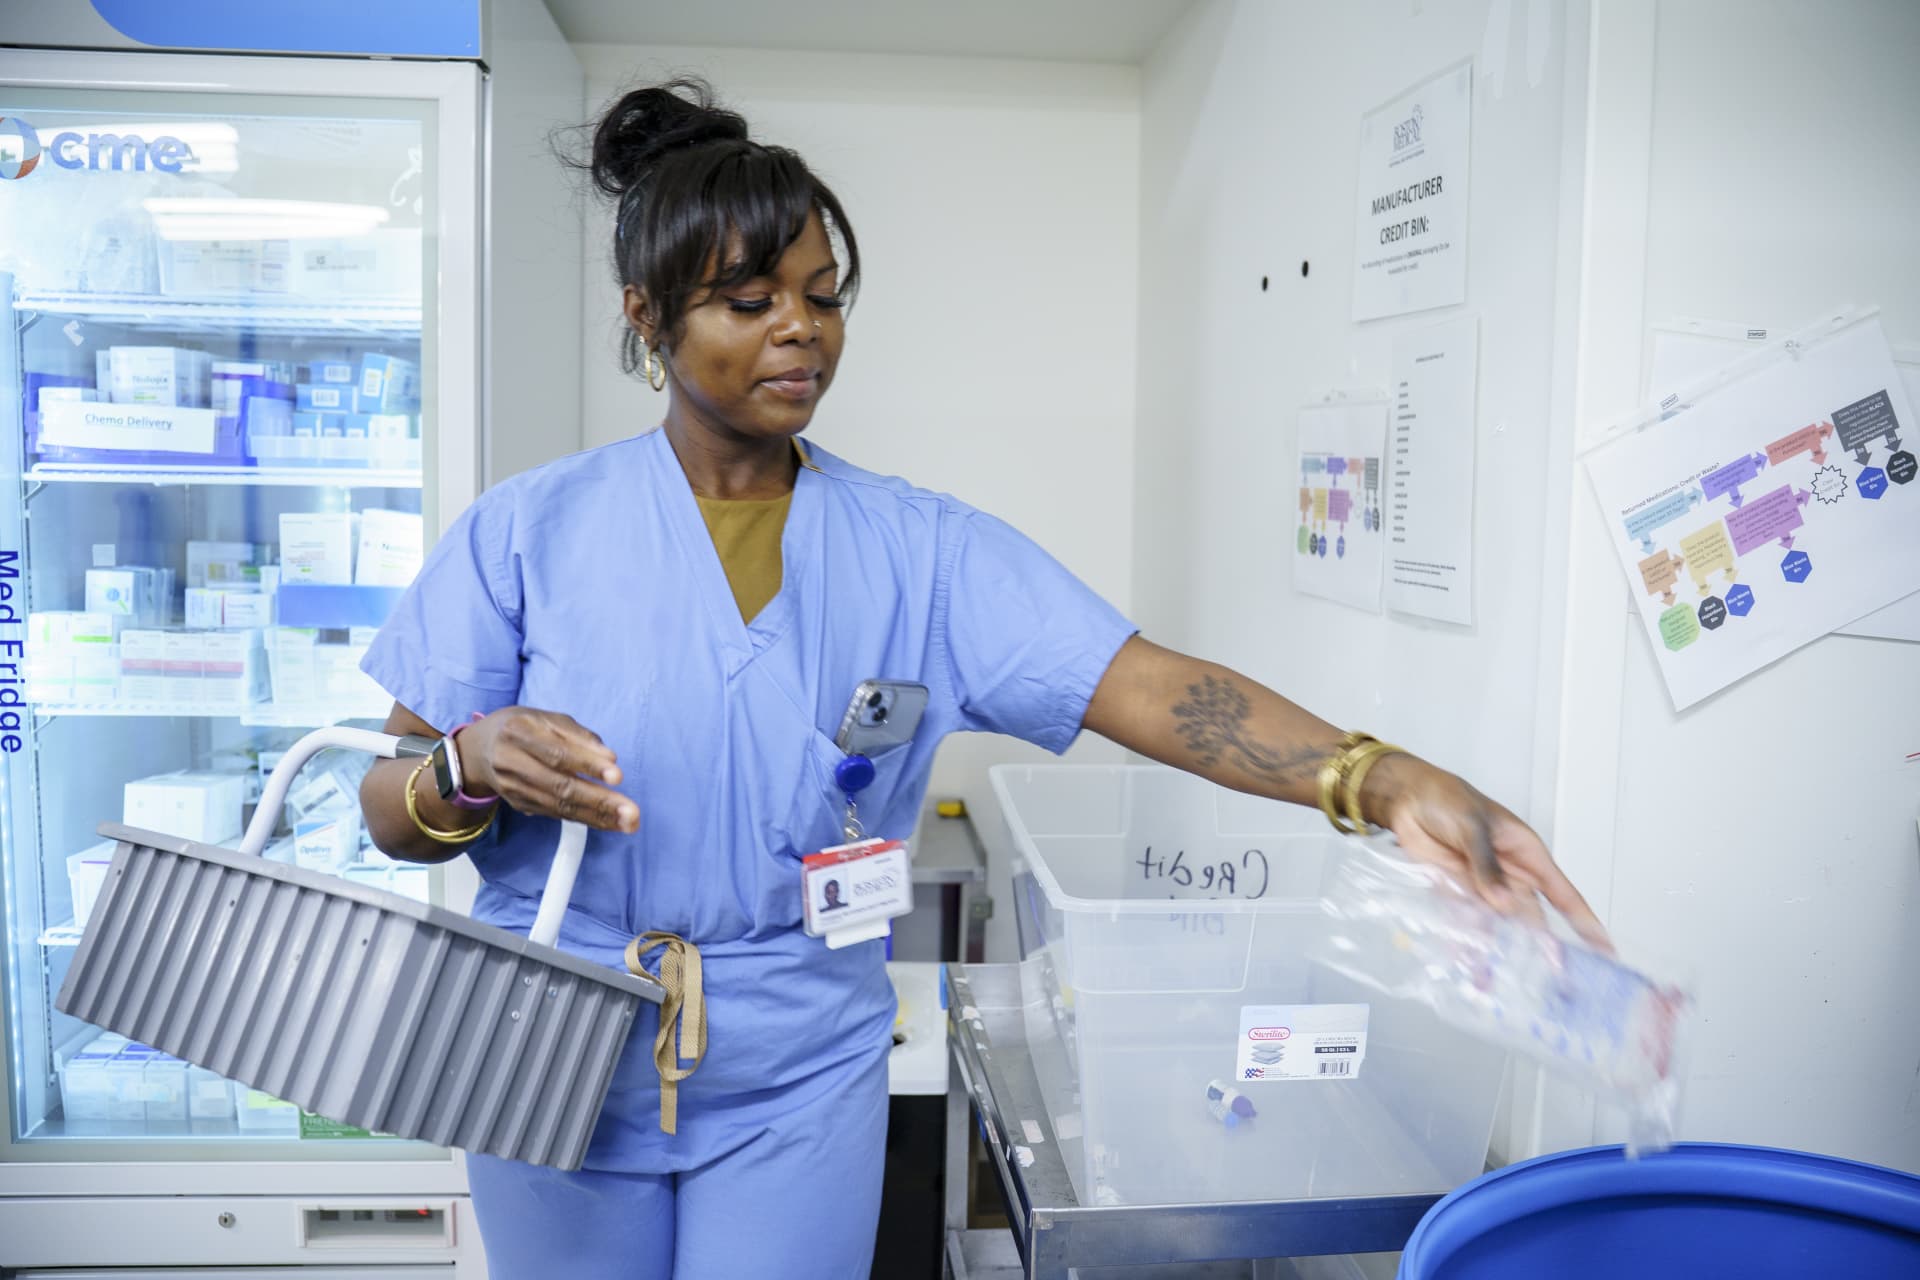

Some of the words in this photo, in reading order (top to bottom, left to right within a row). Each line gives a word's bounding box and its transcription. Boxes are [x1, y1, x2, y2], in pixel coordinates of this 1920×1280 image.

[51, 132, 187, 172] cme
[1372, 175, 1443, 216] MANUFACTURER
[1380, 221, 1409, 245] CREDIT
[1411, 216, 1430, 236] BIN:
[1869, 402, 1885, 411] BLACK
[85, 413, 124, 426] Chemo
[127, 416, 173, 431] Delivery
[1621, 500, 1646, 515] Returned
[1680, 475, 1695, 487] Credit
[1702, 462, 1720, 476] Waste?
[1794, 557, 1807, 566] Waste
[0, 551, 22, 623] Med
[1737, 590, 1750, 599] Waste
[0, 640, 27, 753] Fridge
[1253, 1029, 1286, 1039] Sterilite
